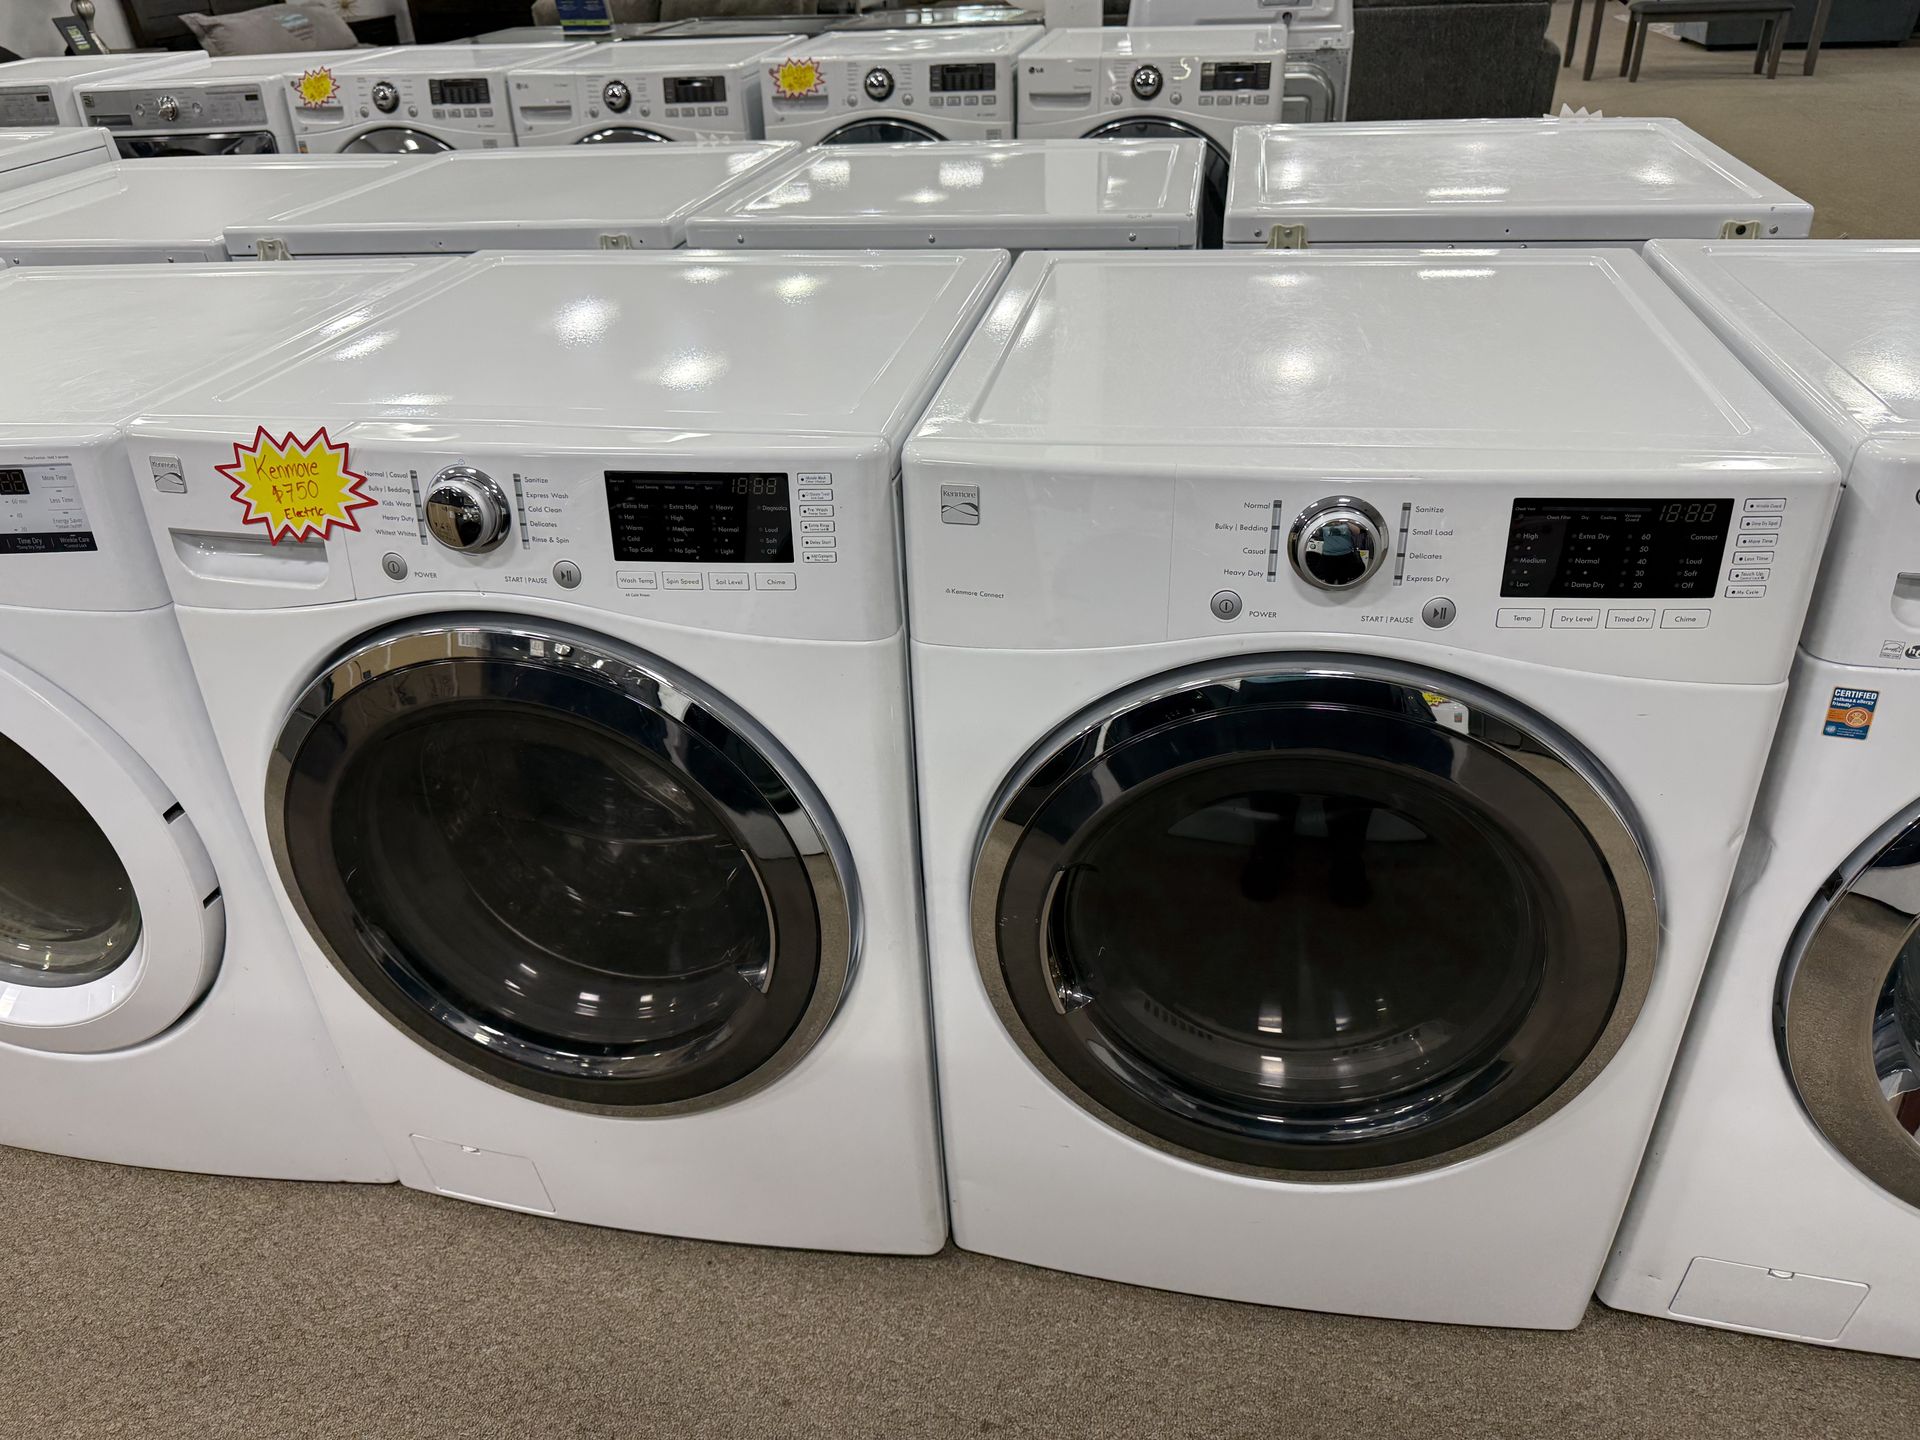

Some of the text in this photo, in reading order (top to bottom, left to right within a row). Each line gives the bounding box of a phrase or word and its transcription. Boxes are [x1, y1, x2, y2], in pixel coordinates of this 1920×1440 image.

[254, 455, 319, 481] Kenmore
[272, 480, 318, 504] $750
[388, 486, 410, 494] Bedding
[943, 490, 976, 498] Kenmore
[526, 492, 549, 500] Express
[684, 504, 698, 512] High
[1244, 502, 1270, 510] Normal
[284, 506, 326, 519] Electric
[400, 514, 414, 522] Duty
[530, 520, 558, 528] Delicates
[1214, 522, 1268, 533] Bulky Bedding
[1412, 528, 1454, 536] Small Load
[1523, 532, 1538, 540] High
[1598, 533, 1610, 541] Dry
[32, 537, 42, 546] Dry
[556, 537, 570, 546] Spin
[1242, 548, 1266, 556] Casual
[1409, 552, 1443, 560] Delicates
[1224, 568, 1264, 578] Heavy Duty
[666, 578, 680, 586] Spin
[1406, 574, 1450, 584] Express Dry
[1571, 582, 1605, 590] Damp Dry
[952, 588, 1004, 599] Kenmore Connect
[1248, 610, 1277, 619] POWER
[1361, 615, 1414, 624] START PAUSE
[1834, 688, 1878, 700] CERTIFIED
